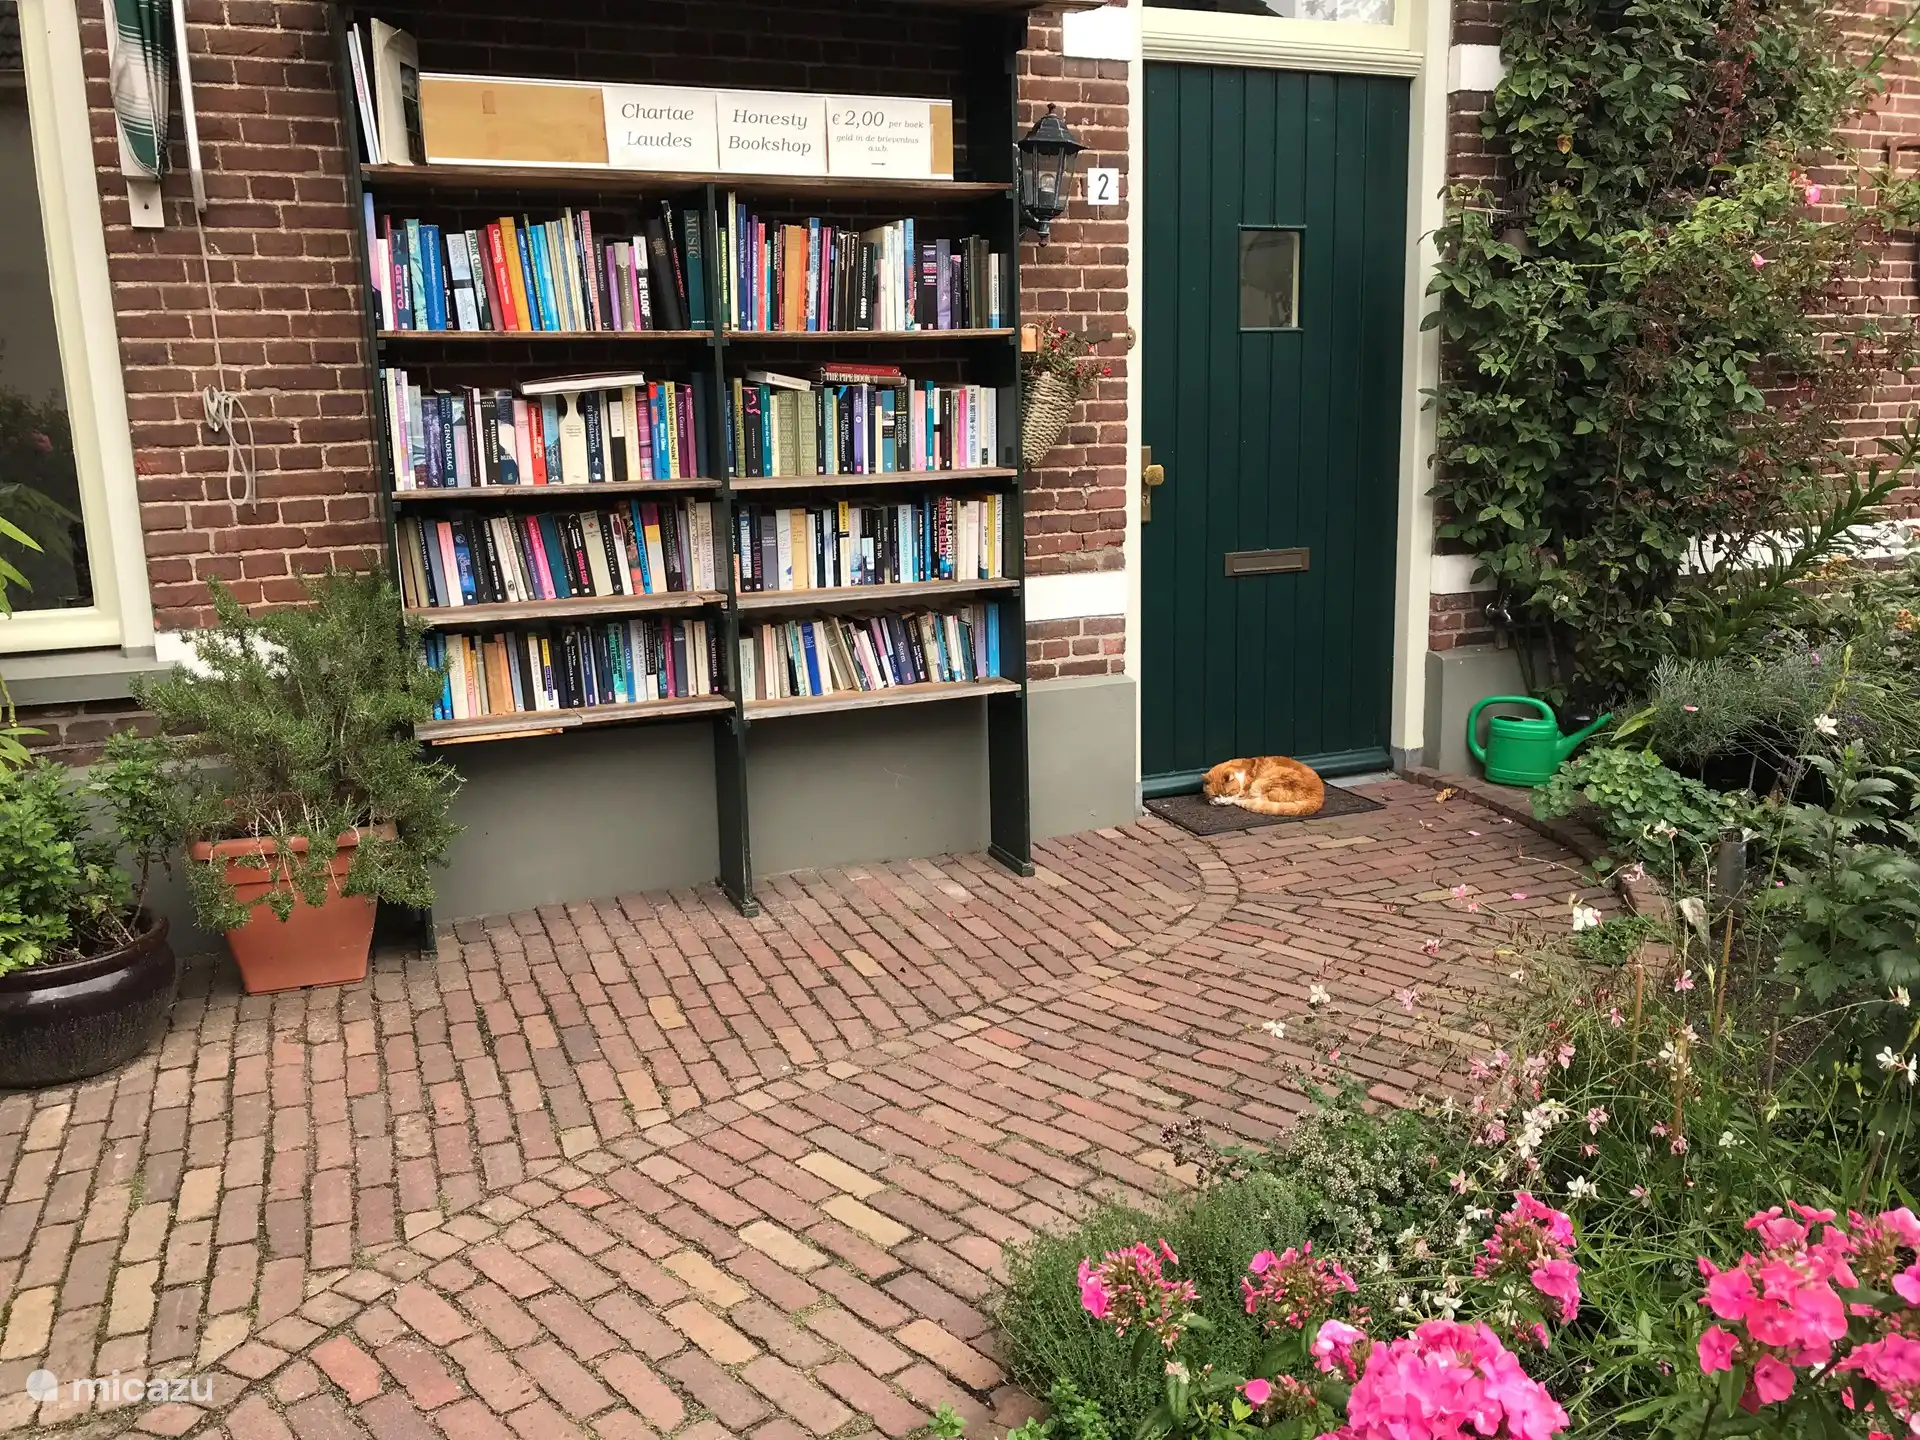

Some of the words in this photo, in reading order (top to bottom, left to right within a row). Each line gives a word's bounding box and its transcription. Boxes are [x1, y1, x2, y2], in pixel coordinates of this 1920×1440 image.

[621, 103, 694, 122] Chartae
[733, 109, 808, 130] Honesty
[844, 110, 885, 129] 2,00
[889, 121, 902, 129] per
[905, 119, 924, 129] boek
[627, 132, 692, 148] Laudes
[728, 136, 811, 156] Bookshop
[1098, 173, 1109, 200] 2
[492, 229, 504, 264] Christmas
[686, 216, 699, 259] MUSIC
[468, 232, 478, 256] MARK
[473, 258, 484, 282] CLARK
[395, 264, 404, 310] GETTO
[639, 277, 648, 289] DE
[640, 289, 650, 317] KLOOF
[860, 297, 868, 319] CONGO
[853, 373, 870, 383] BOOK
[897, 415, 902, 423] EN
[902, 415, 907, 423] DE
[587, 413, 596, 454] SPIEGELMAKER
[444, 423, 453, 471] GENADESLAG
[945, 496, 953, 521] JENS
[704, 539, 712, 574] HOLLAND
[945, 523, 953, 565] LAPIDUS
[637, 641, 645, 680] SARAMAGO
[897, 641, 907, 663] Storm
